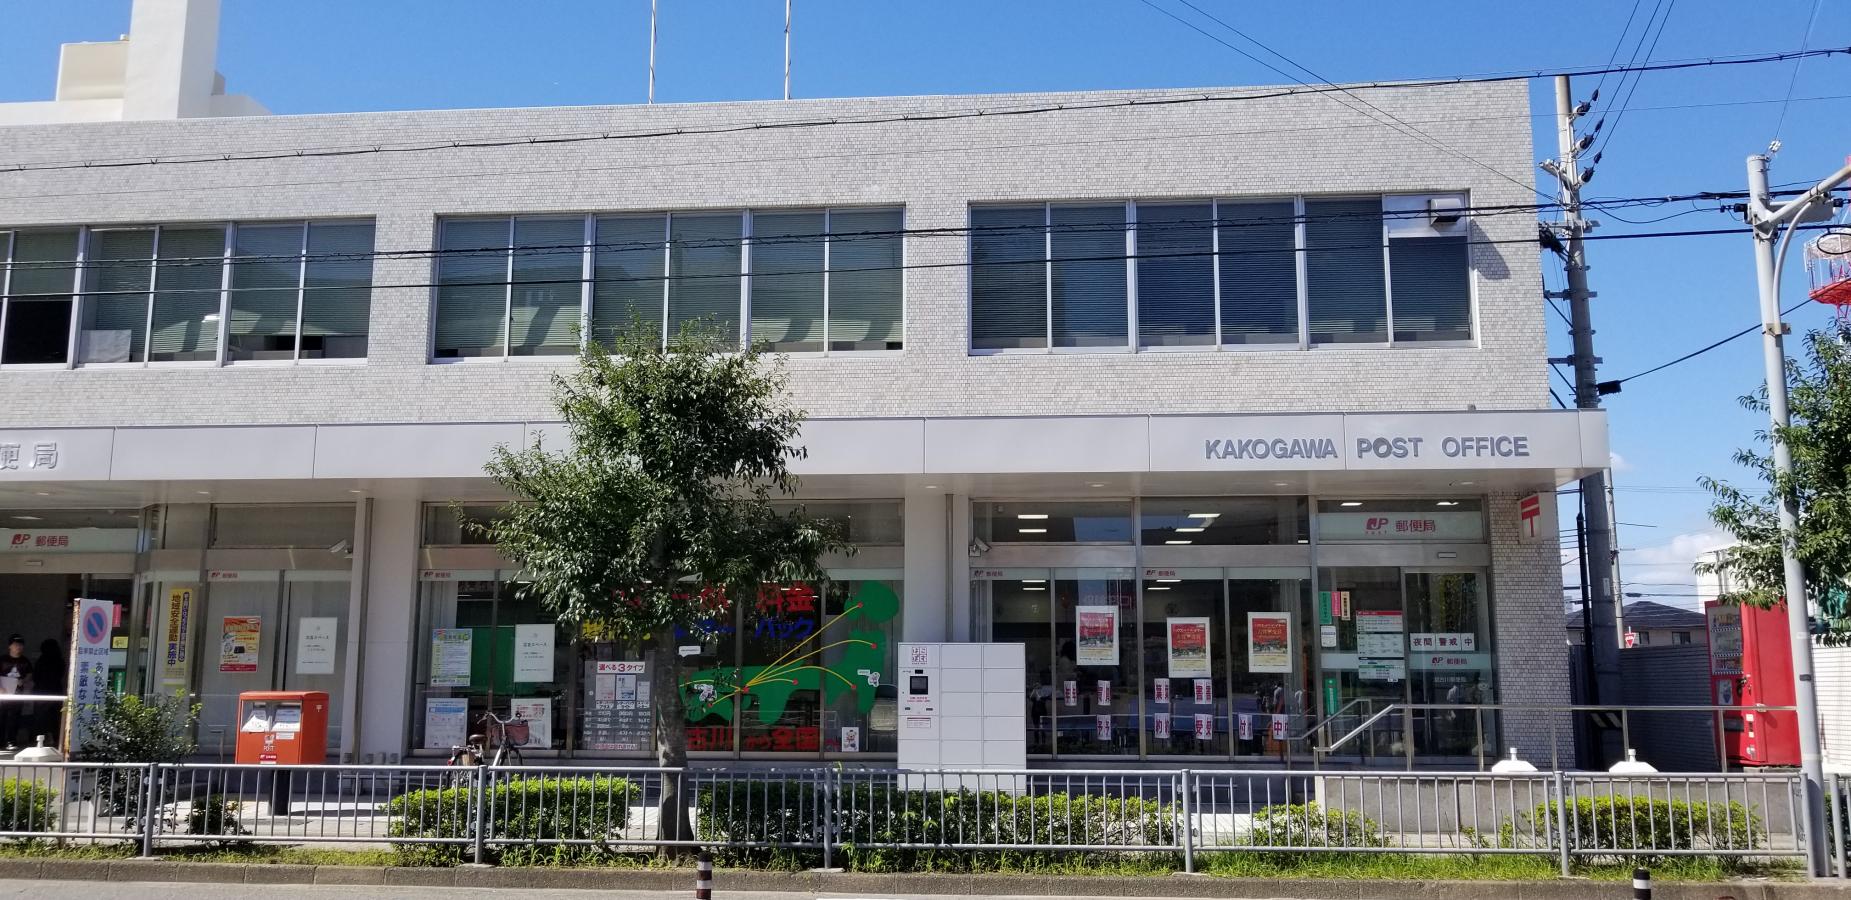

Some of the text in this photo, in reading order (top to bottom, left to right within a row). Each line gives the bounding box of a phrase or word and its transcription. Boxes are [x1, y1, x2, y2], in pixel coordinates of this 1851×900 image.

[1205, 436, 1530, 460] KAKOGAWA POST OFFICE
[1395, 519, 1436, 533] 郵便局
[35, 535, 69, 547] 郵便局
